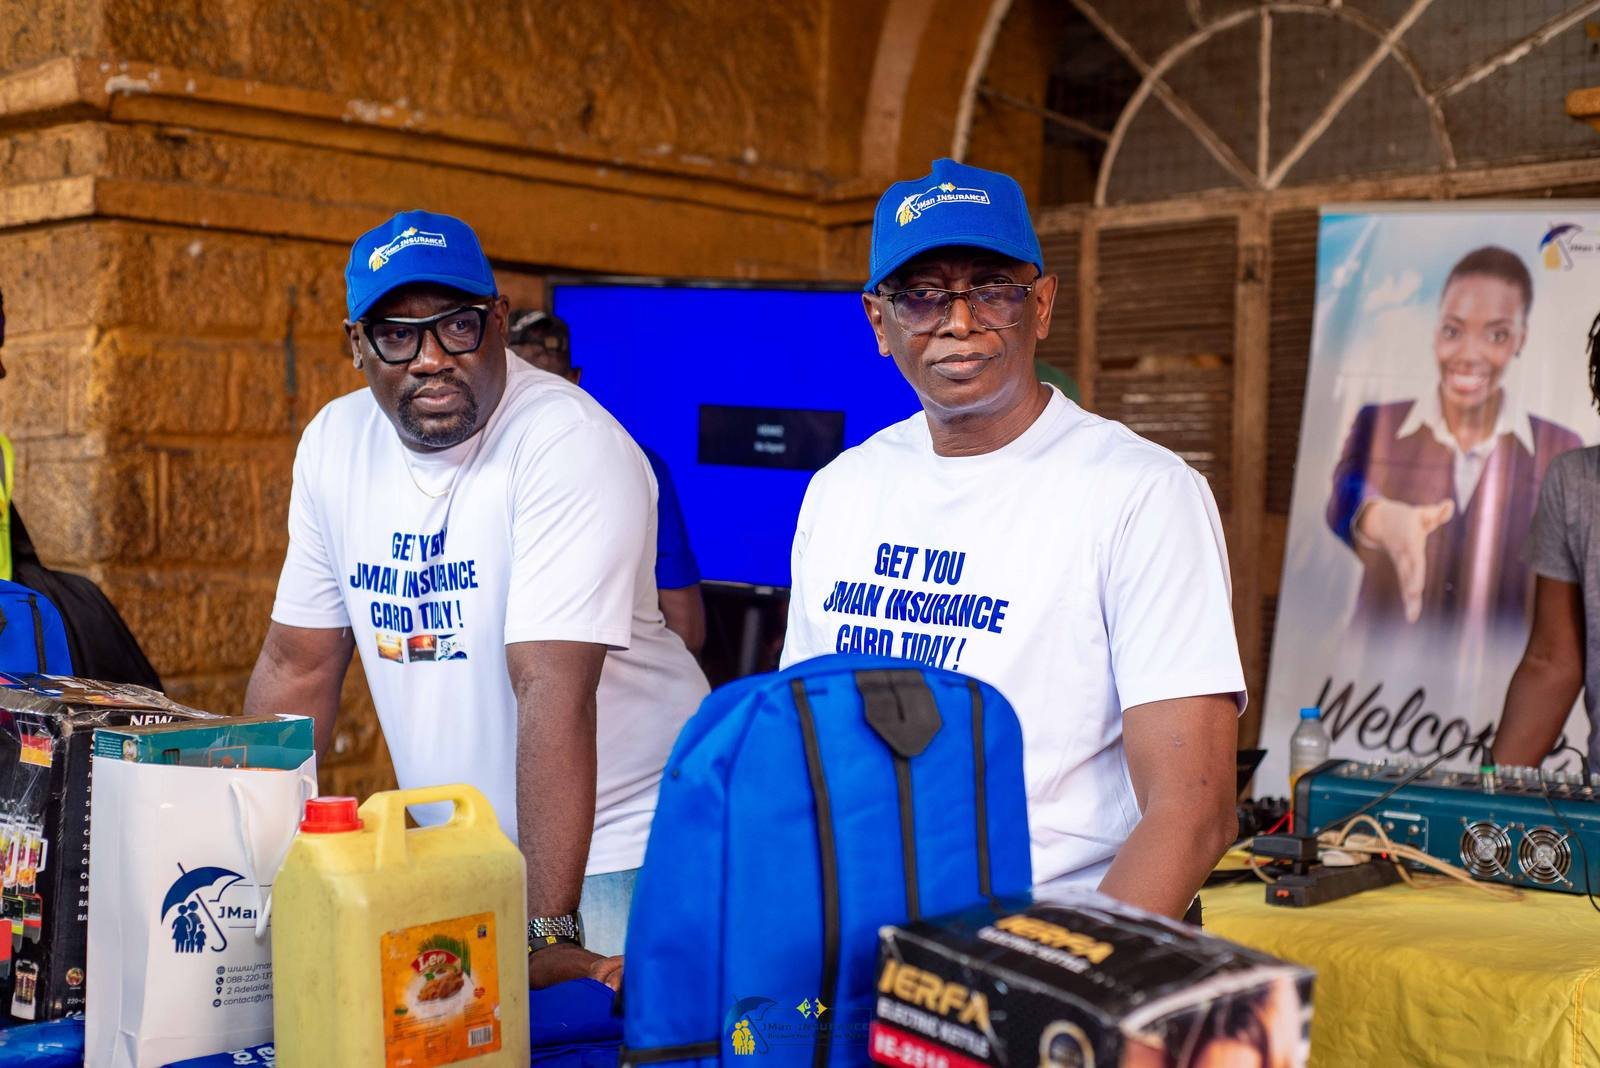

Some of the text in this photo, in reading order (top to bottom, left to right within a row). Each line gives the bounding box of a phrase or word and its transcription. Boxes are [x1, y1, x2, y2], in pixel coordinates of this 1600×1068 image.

[936, 194, 987, 202] INSURANCE
[350, 562, 398, 597] JMAN
[874, 542, 966, 586] GET YOU
[370, 601, 414, 633] CARD
[823, 580, 1010, 634] JMAN INSURANCE
[835, 624, 895, 657] CARD
